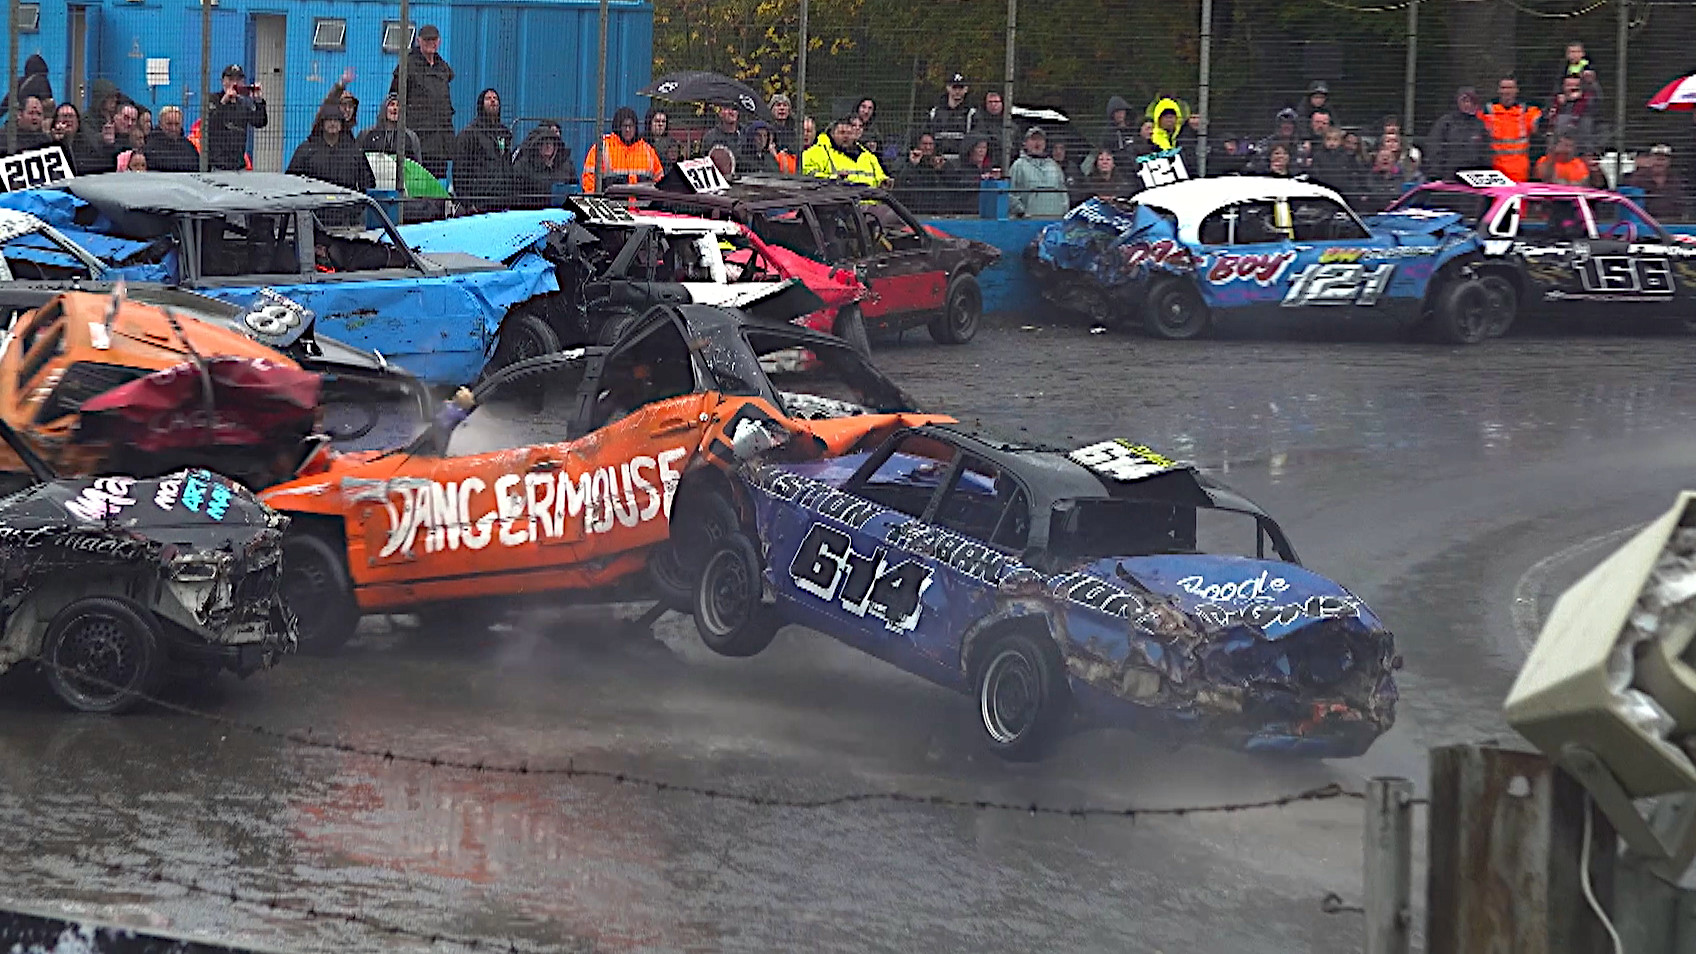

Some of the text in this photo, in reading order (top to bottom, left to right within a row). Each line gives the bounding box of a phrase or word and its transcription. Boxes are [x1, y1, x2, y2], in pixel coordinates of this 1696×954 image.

[5, 150, 66, 190] 202
[686, 164, 720, 189] 377
[1137, 154, 1189, 188] 121
[1207, 249, 1296, 286] BOY
[1280, 264, 1395, 307] 121
[1571, 256, 1676, 293] 156
[378, 448, 687, 558] DANGERMOUSE
[789, 522, 935, 635] 614
